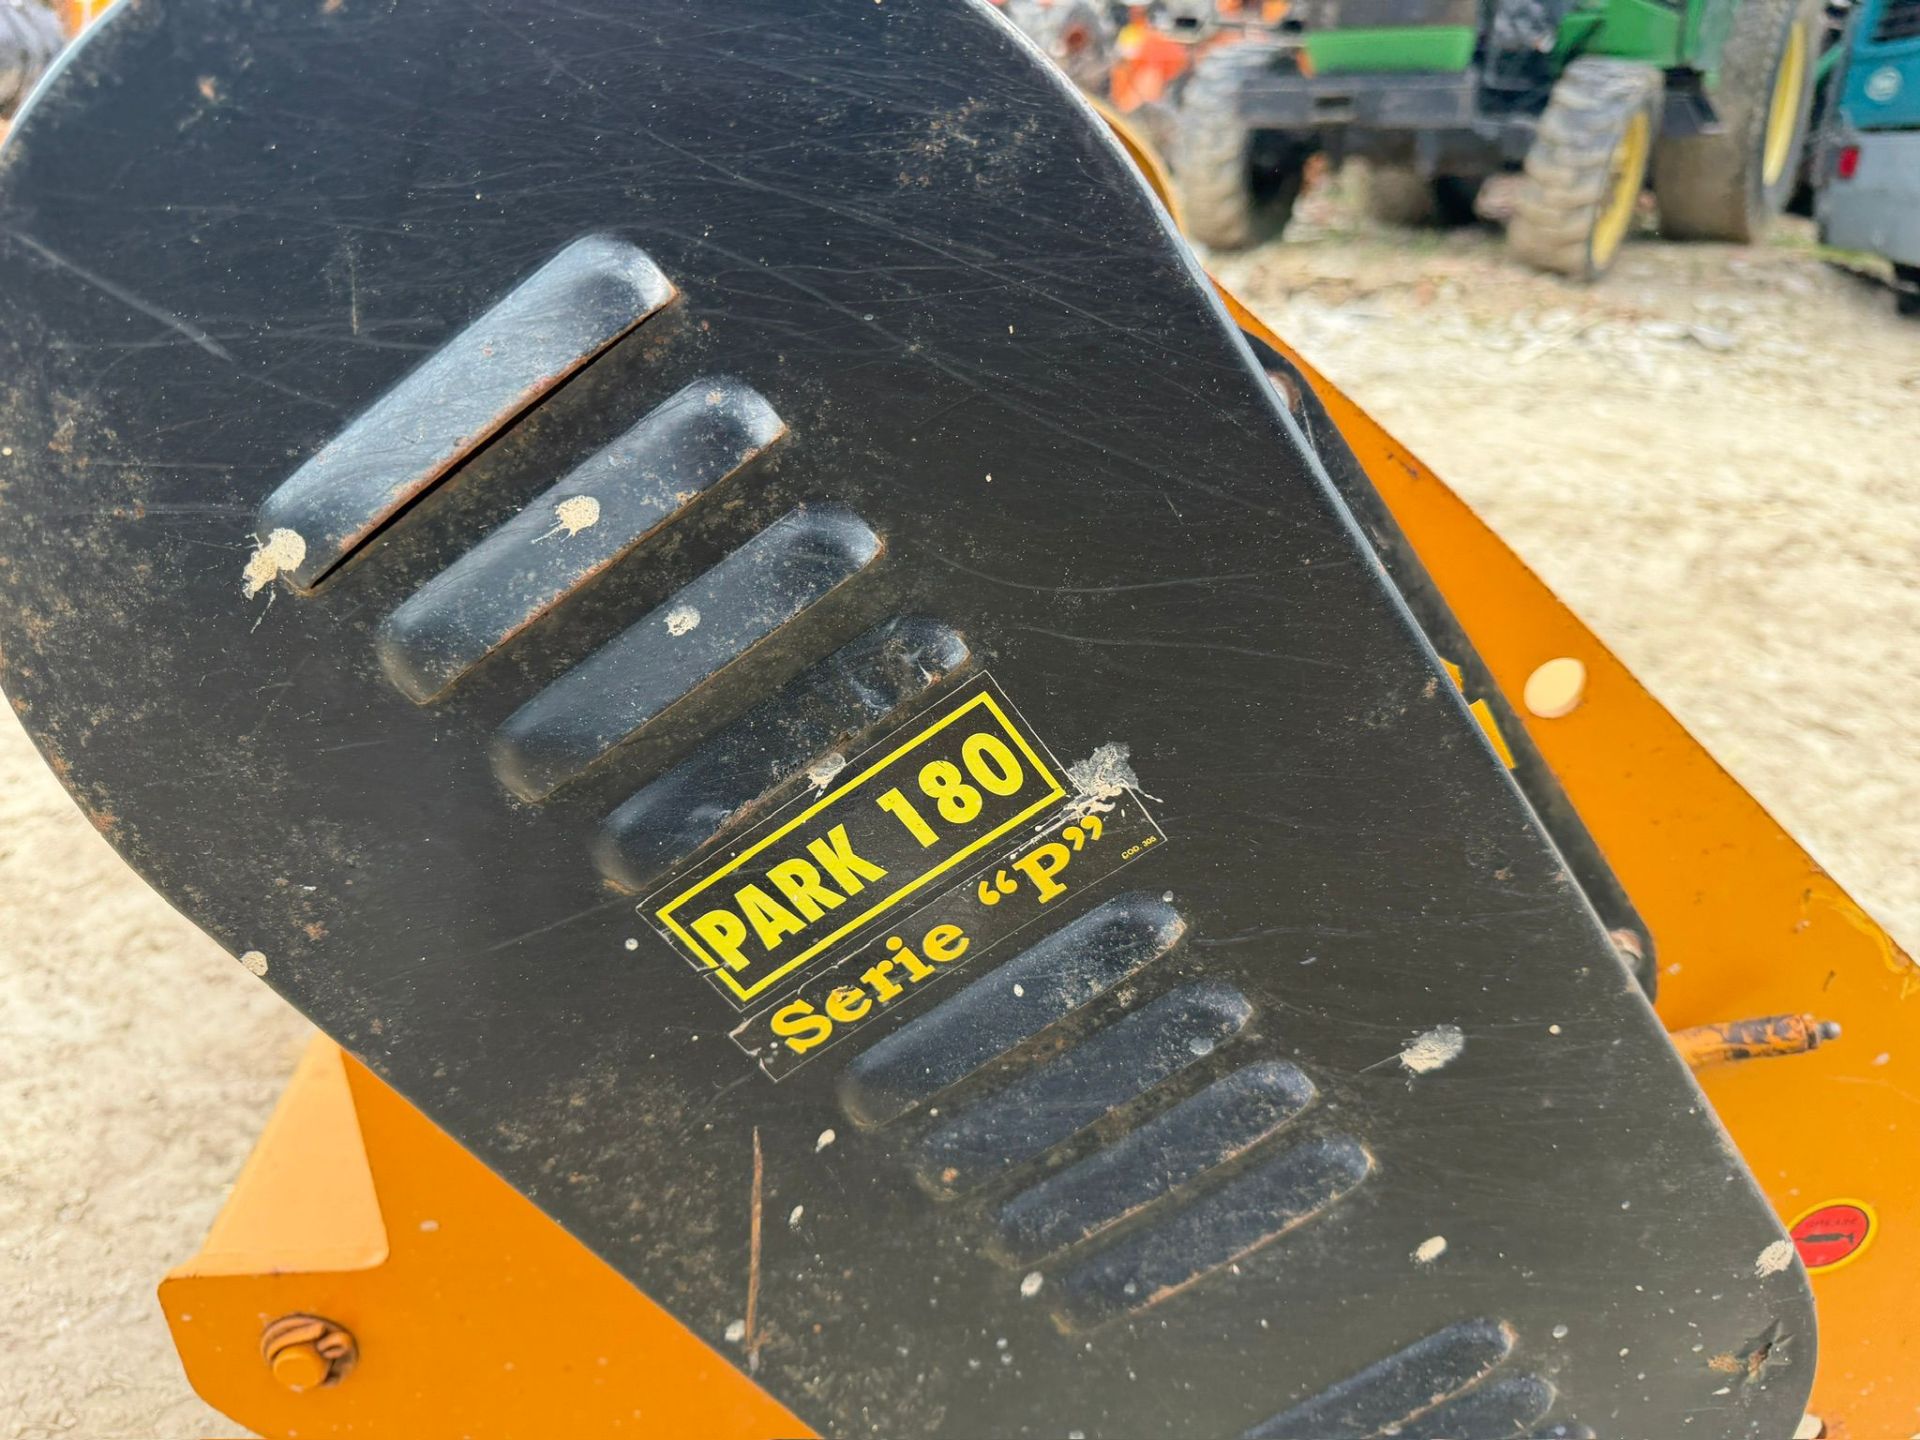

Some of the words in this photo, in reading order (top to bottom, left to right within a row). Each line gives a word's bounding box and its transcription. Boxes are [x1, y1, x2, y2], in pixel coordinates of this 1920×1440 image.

[691, 824, 888, 972] PARK
[876, 733, 1024, 848] 180
[770, 924, 970, 1055] Serie
